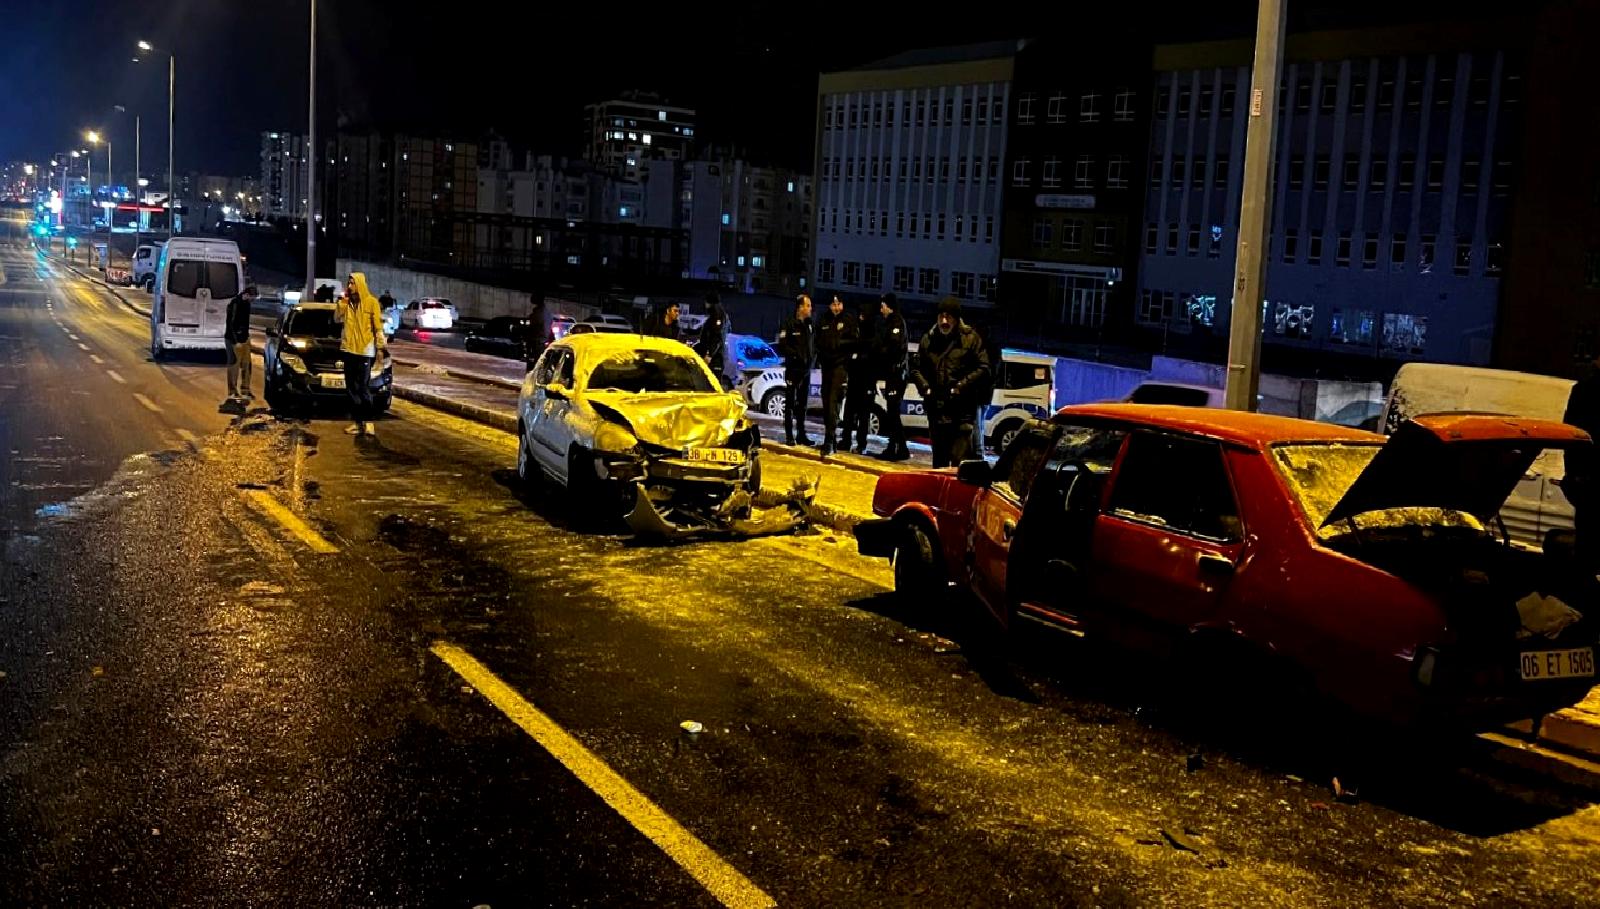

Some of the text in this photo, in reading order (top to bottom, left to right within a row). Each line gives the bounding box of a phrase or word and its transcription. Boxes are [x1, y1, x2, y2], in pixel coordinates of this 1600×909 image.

[1523, 651, 1593, 677] 06 ET 1505
